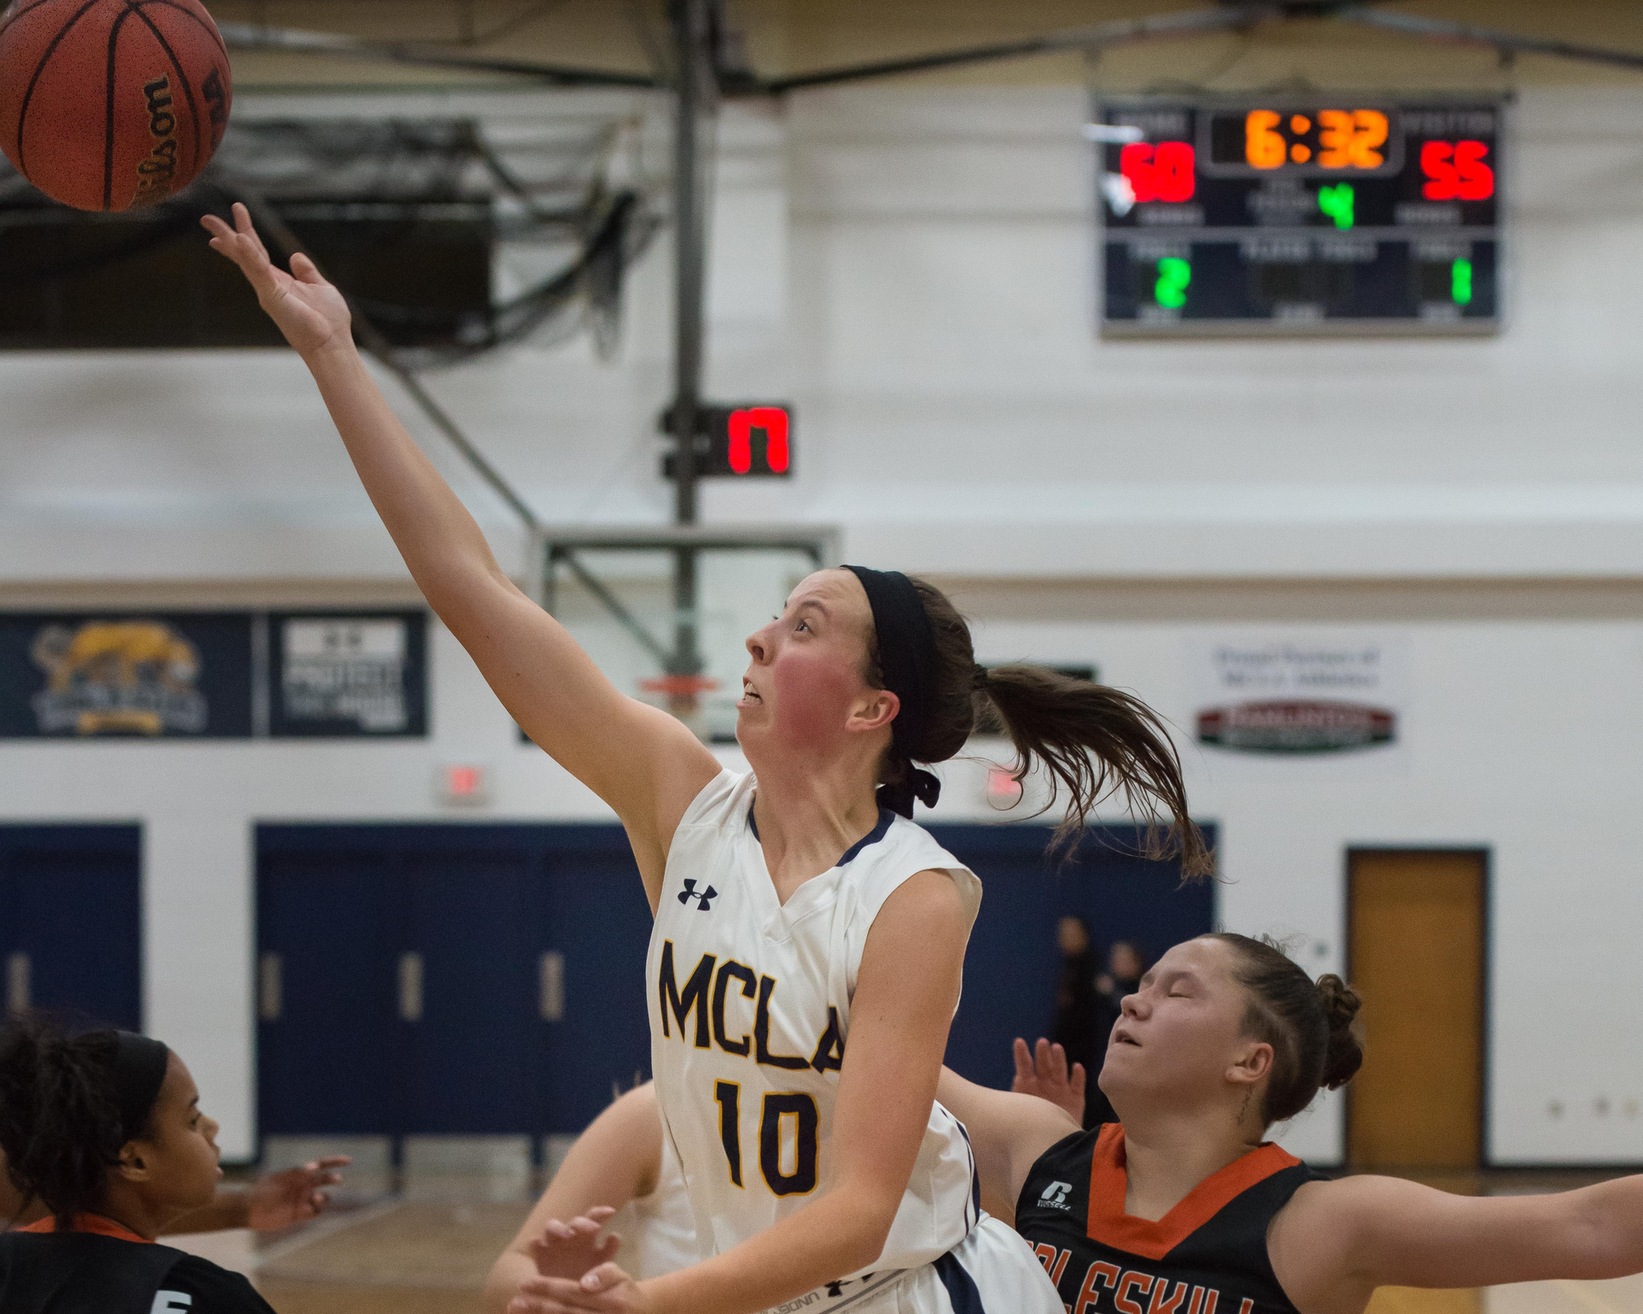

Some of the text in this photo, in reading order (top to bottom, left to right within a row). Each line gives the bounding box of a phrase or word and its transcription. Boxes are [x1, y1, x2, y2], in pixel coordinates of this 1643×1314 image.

[1245, 109, 1389, 169] 6:32
[1121, 141, 1195, 202] 60
[1420, 140, 1494, 200] 55
[1318, 182, 1354, 230] 4
[1155, 257, 1191, 308] 2
[1452, 258, 1472, 305] 1
[658, 938, 845, 1074] MCLA
[714, 1078, 820, 1198] 10
